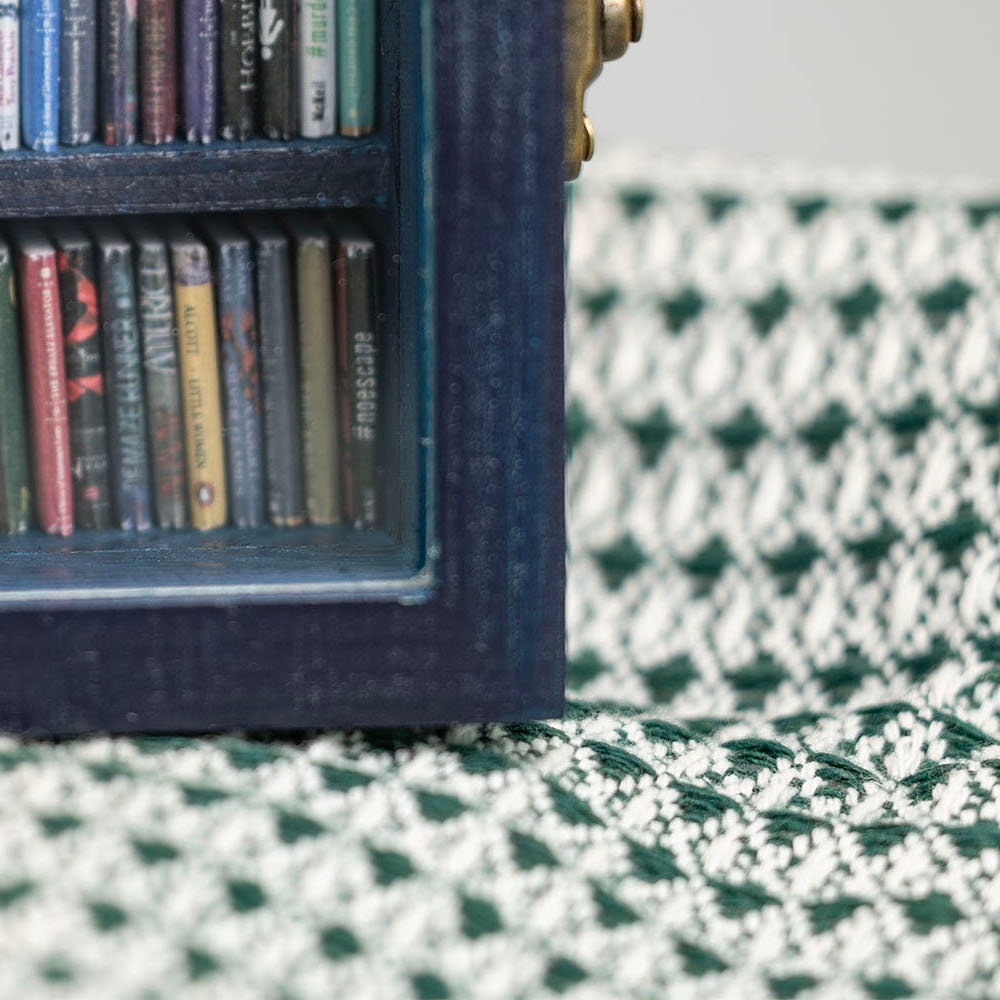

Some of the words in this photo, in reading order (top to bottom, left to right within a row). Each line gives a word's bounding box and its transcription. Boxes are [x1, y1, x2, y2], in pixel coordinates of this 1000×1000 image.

[184, 305, 199, 355] ALCOTT
[49, 379, 60, 398] THE
[188, 377, 203, 420] LITTLE
[353, 331, 376, 441] #noescape
[120, 405, 144, 464] MAZE
[191, 422, 206, 469] WOMEN
